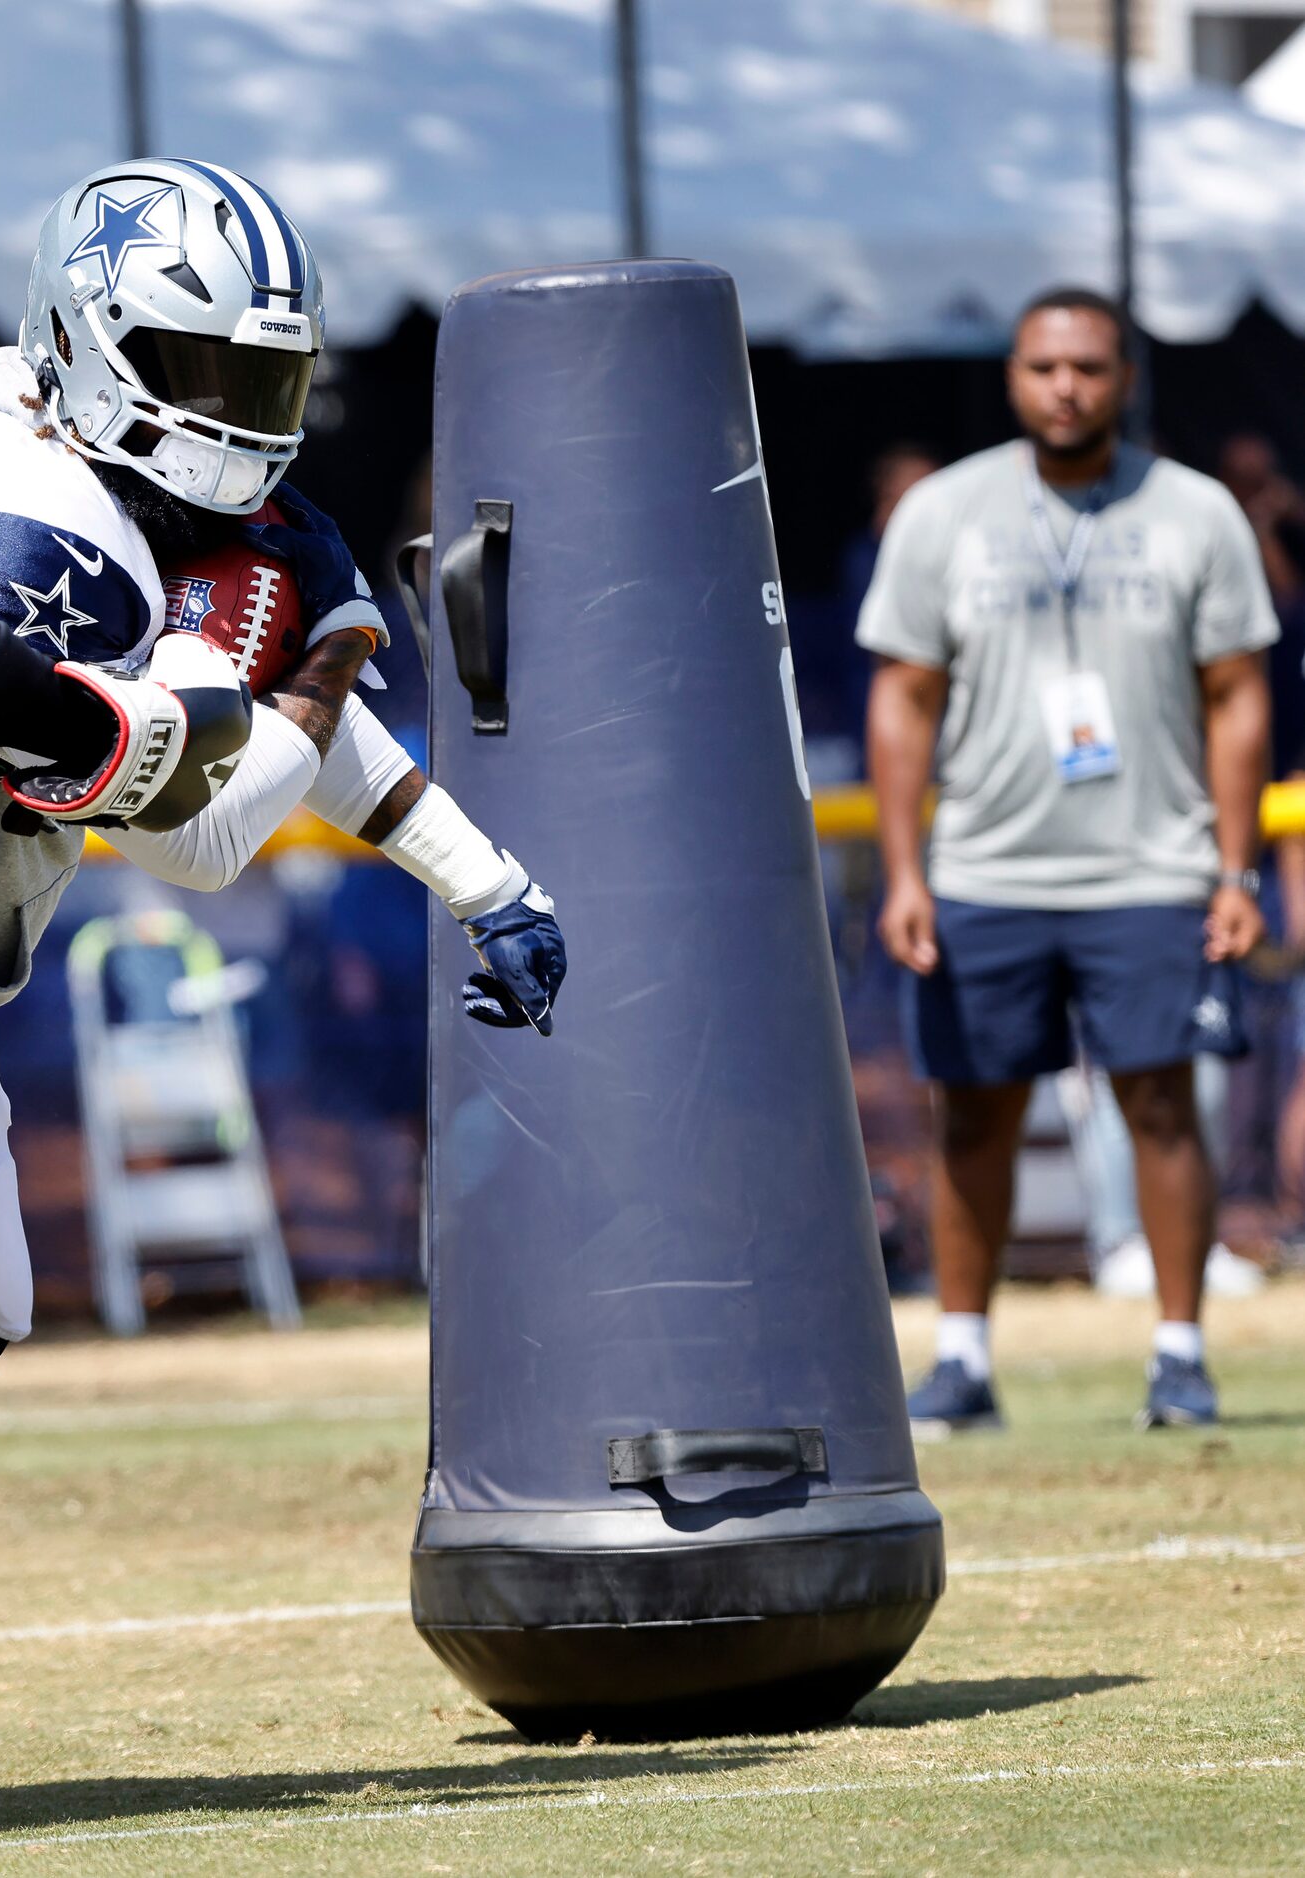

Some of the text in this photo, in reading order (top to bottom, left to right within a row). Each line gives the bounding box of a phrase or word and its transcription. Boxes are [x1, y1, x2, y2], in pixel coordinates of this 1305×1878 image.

[260, 320, 302, 336] COWBOYS
[165, 580, 189, 619] NFL
[116, 726, 173, 806] TITLE
